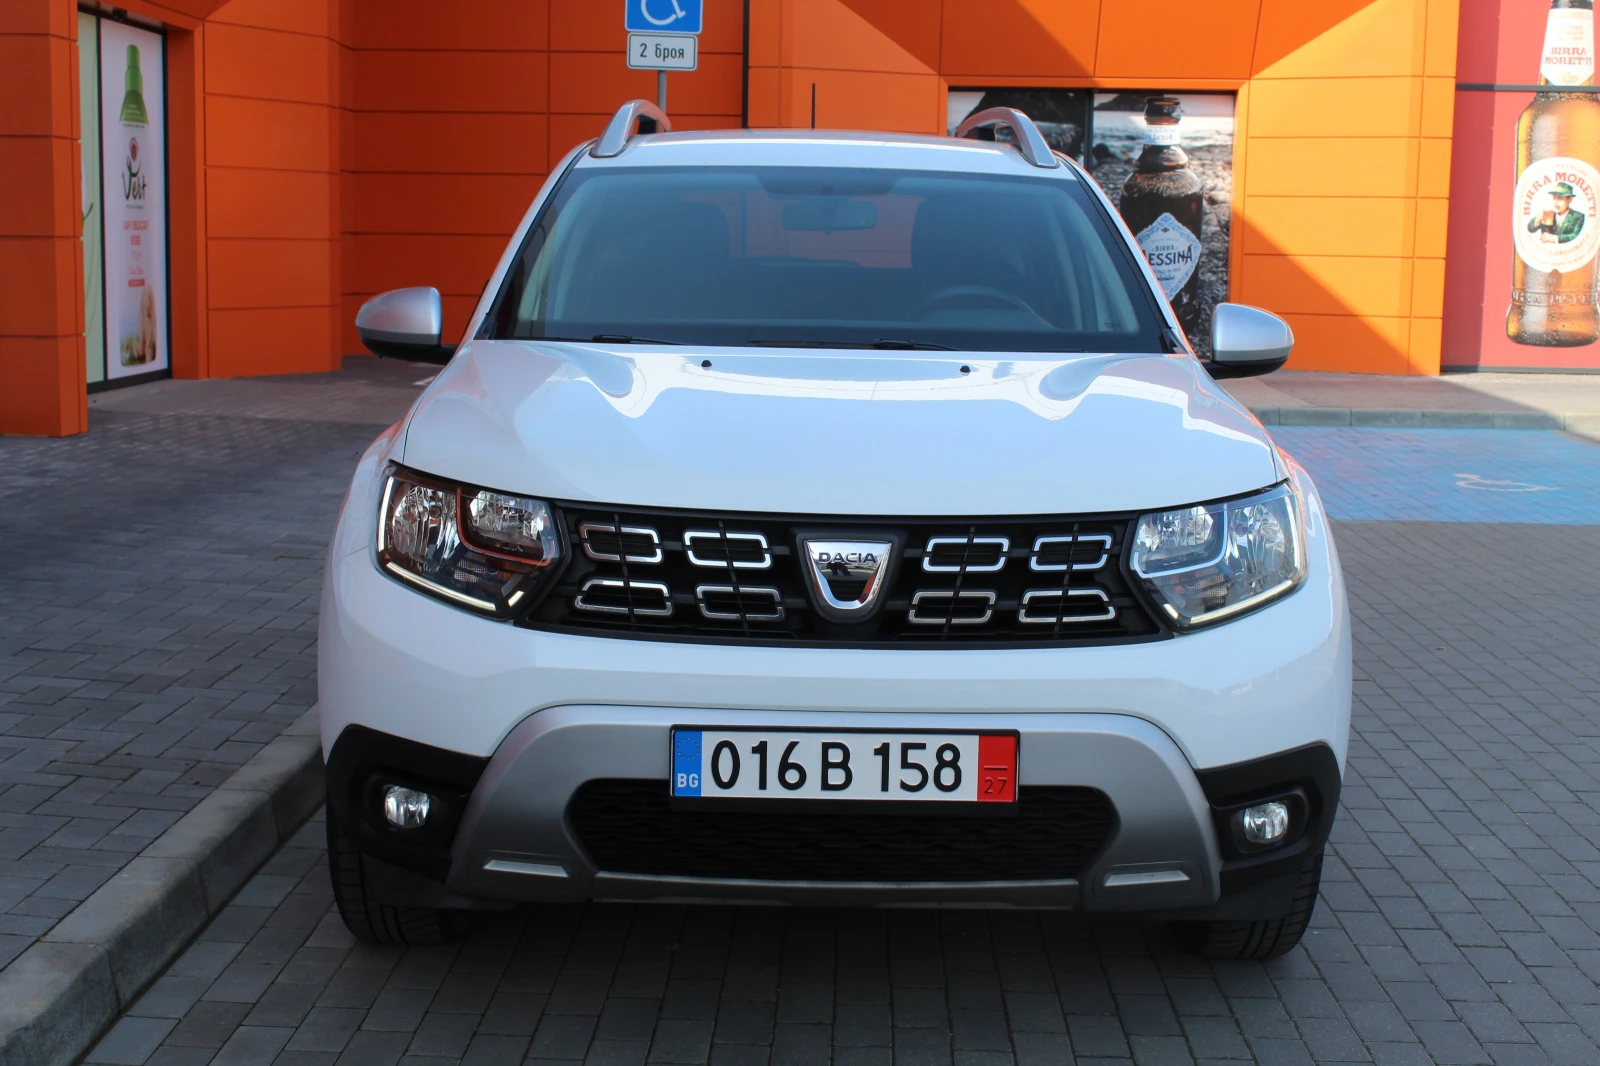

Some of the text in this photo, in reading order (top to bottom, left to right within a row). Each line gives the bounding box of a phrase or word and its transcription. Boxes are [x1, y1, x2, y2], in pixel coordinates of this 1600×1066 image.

[640, 43, 685, 62] 2 броя
[1550, 46, 1588, 56] BIRRA
[1543, 56, 1593, 66] MORETTI
[1523, 171, 1597, 218] BIRRA MORETTI
[1155, 244, 1175, 252] BIRRA
[818, 552, 877, 564] DACIA
[873, 742, 963, 793] 158
[677, 773, 699, 788] BG
[983, 777, 1008, 795] 27
